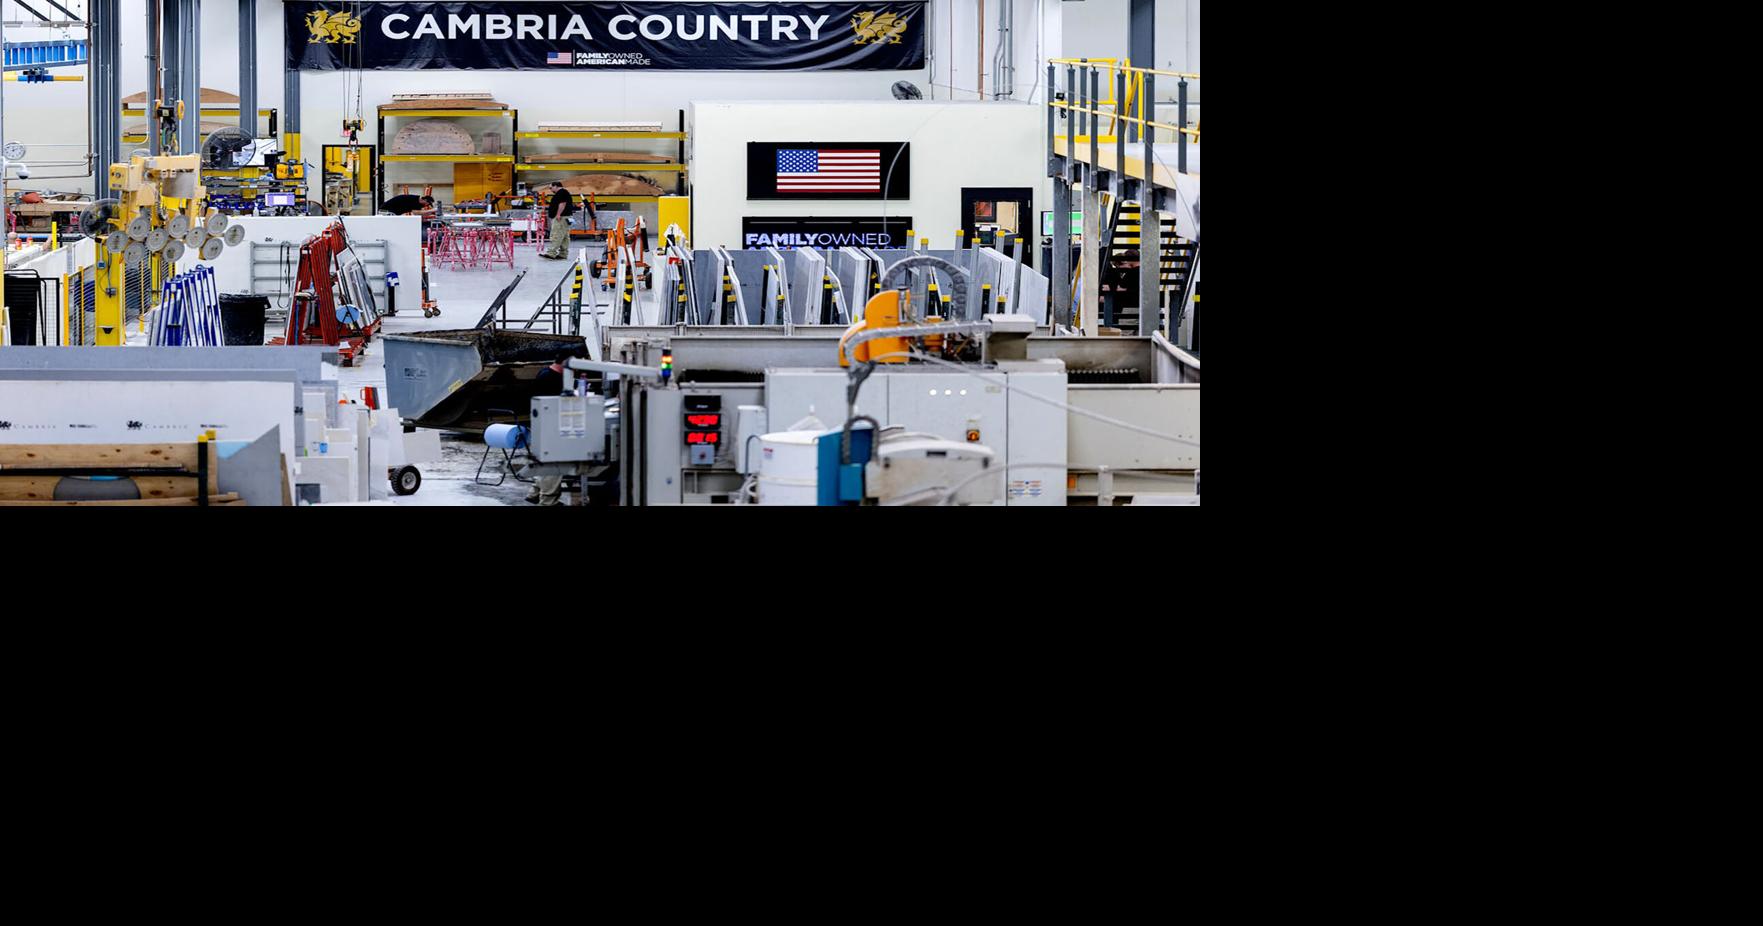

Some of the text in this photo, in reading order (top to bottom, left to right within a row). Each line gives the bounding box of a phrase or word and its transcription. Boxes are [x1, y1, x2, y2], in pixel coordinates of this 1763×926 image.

[381, 13, 830, 41] CAMBRIA COUNTRY
[745, 233, 891, 245] FAMILYOWNED
